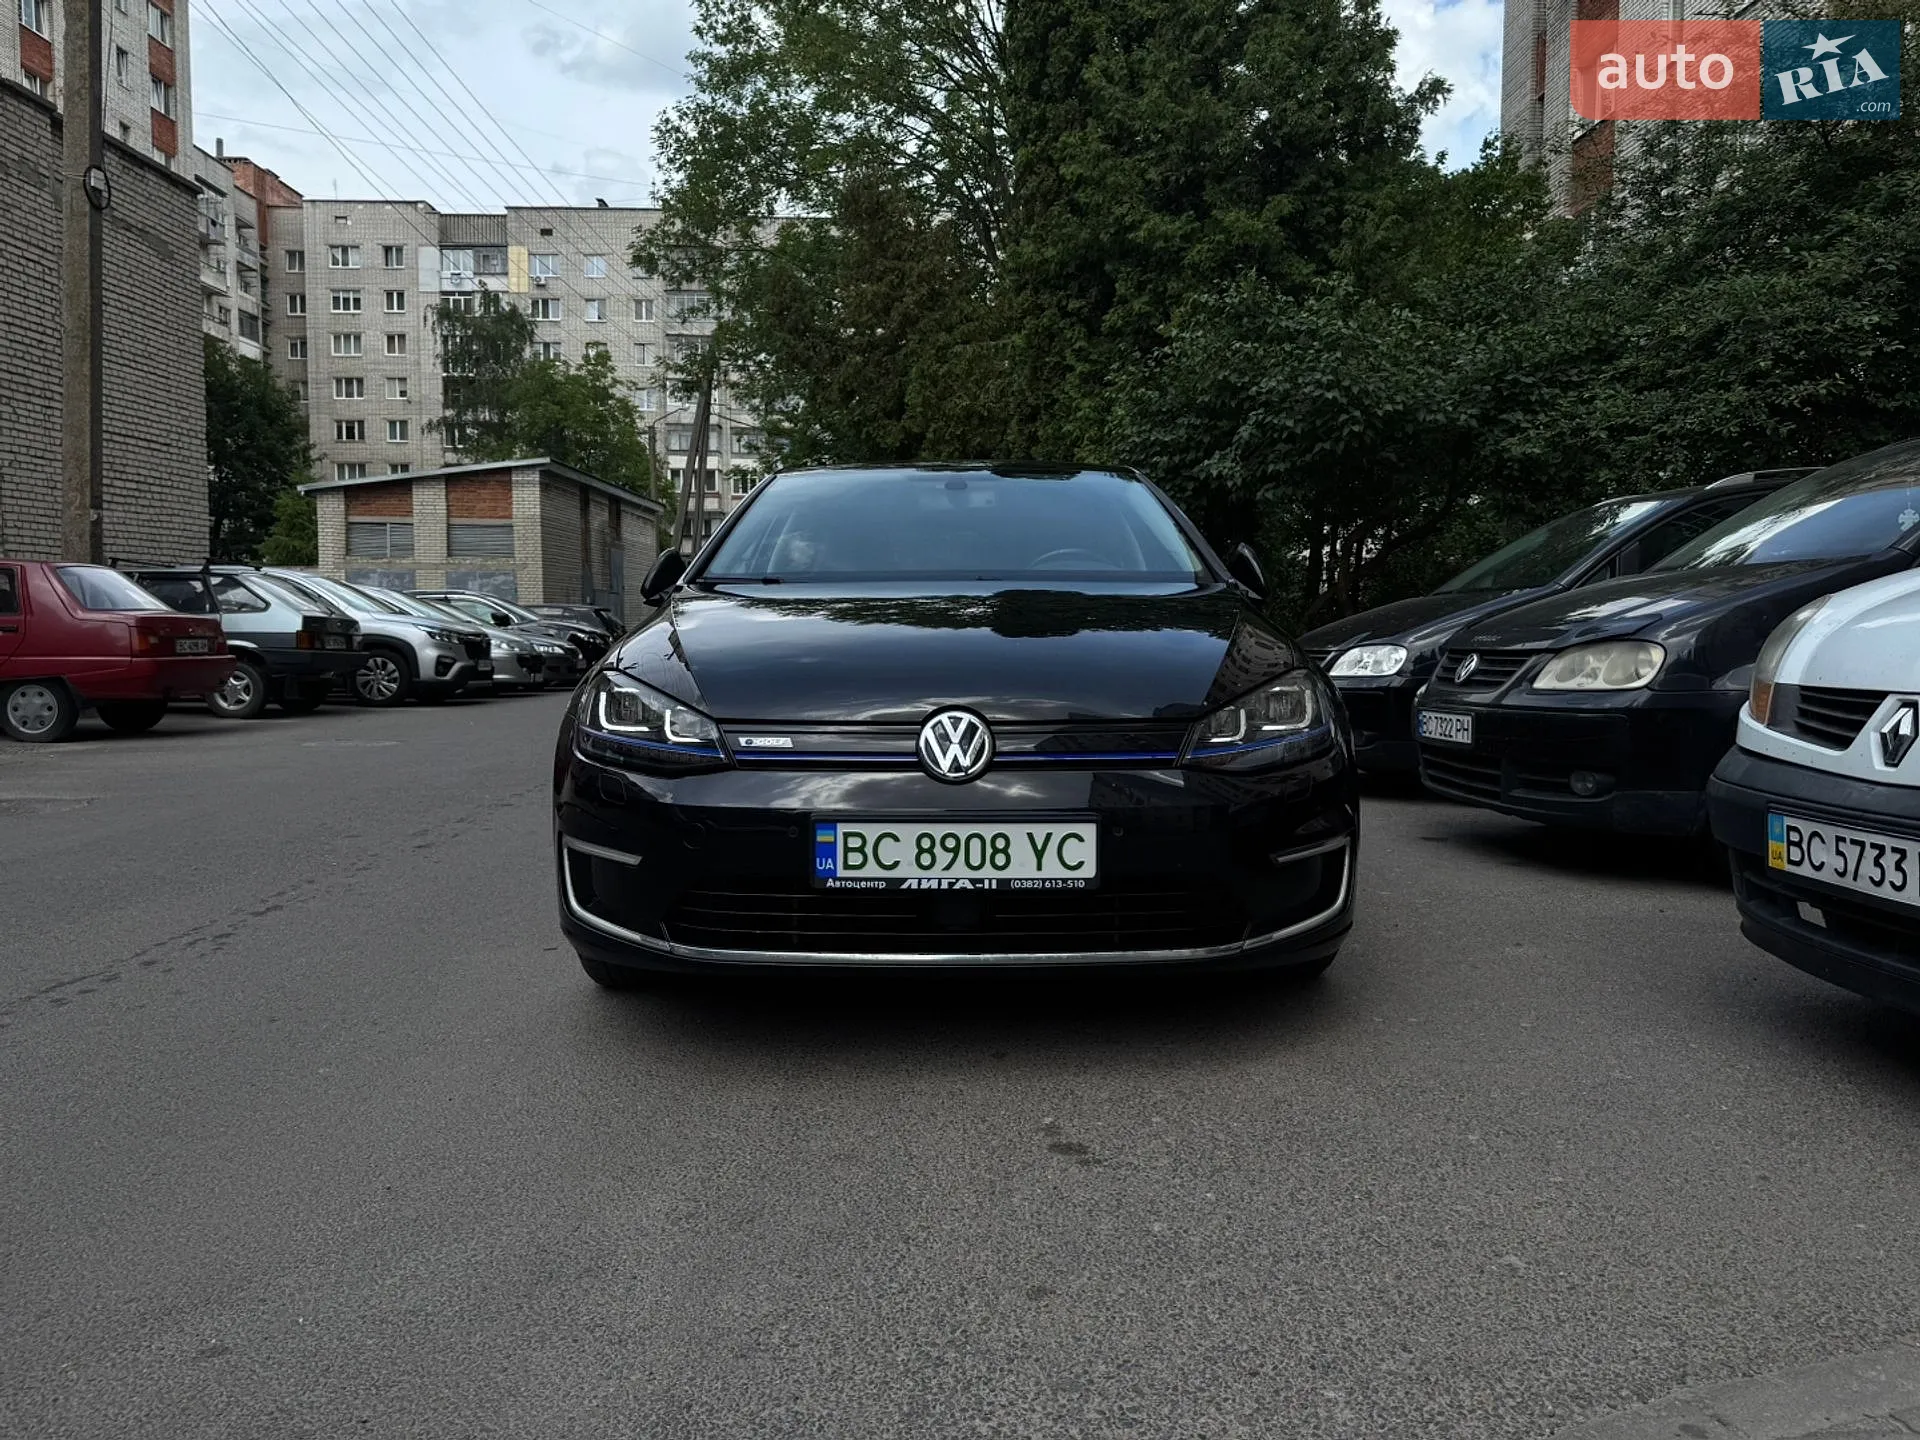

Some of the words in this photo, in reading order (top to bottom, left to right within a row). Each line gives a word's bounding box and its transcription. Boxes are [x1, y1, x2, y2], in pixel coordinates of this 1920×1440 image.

[1423, 715, 1433, 735] BC
[1434, 716, 1454, 738] 7322
[1455, 718, 1470, 741] PH
[919, 711, 991, 780] VW
[816, 858, 834, 870] UA
[841, 831, 901, 872] BC
[914, 832, 1012, 872] 8908
[1026, 832, 1085, 872] YC
[1771, 849, 1784, 862] UA
[1786, 824, 1826, 872] BC
[1834, 835, 1908, 893] 5733
[826, 878, 886, 889] Автоцентр
[1010, 879, 1042, 889] (0382)
[1045, 879, 1085, 889] 613-510
